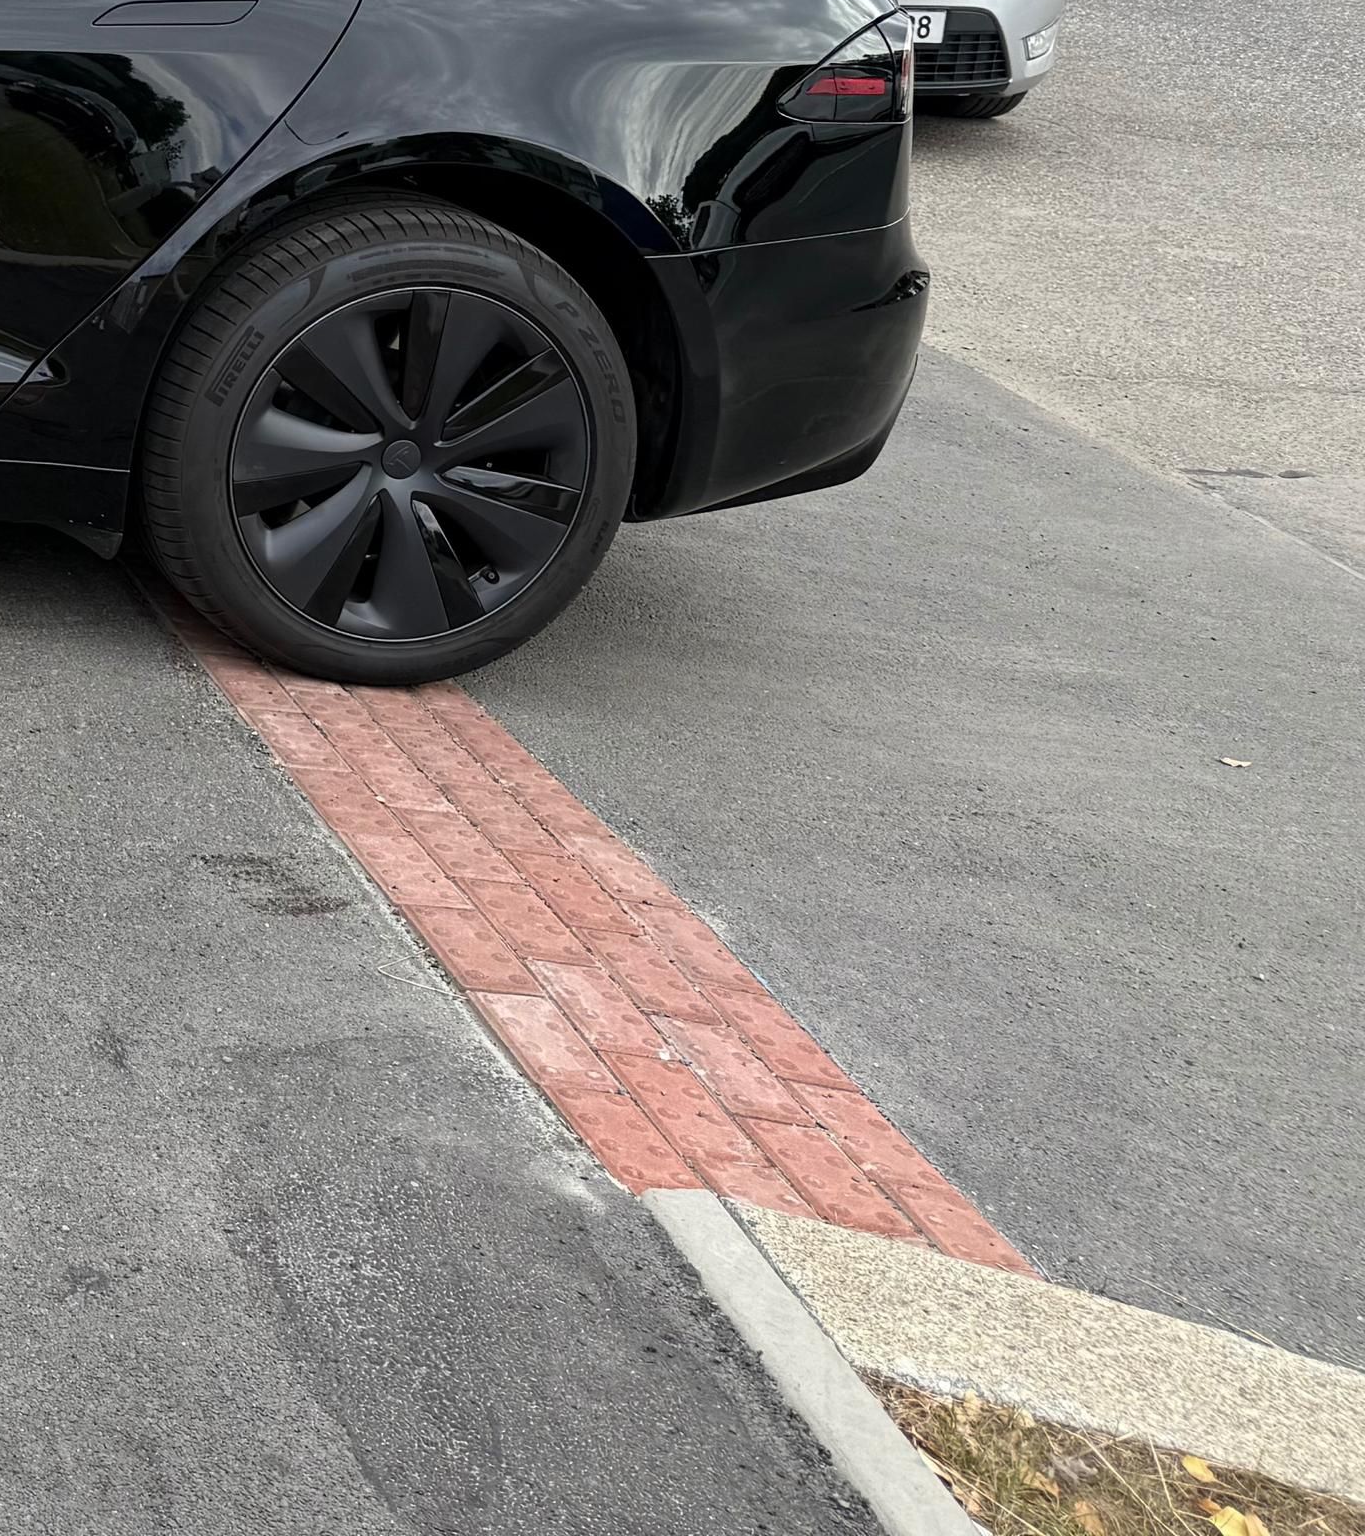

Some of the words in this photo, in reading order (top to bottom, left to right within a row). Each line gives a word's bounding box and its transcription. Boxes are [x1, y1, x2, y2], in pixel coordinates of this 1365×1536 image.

[204, 325, 265, 407] PIRELLI
[555, 301, 580, 318] P
[578, 326, 627, 424] ZERO
